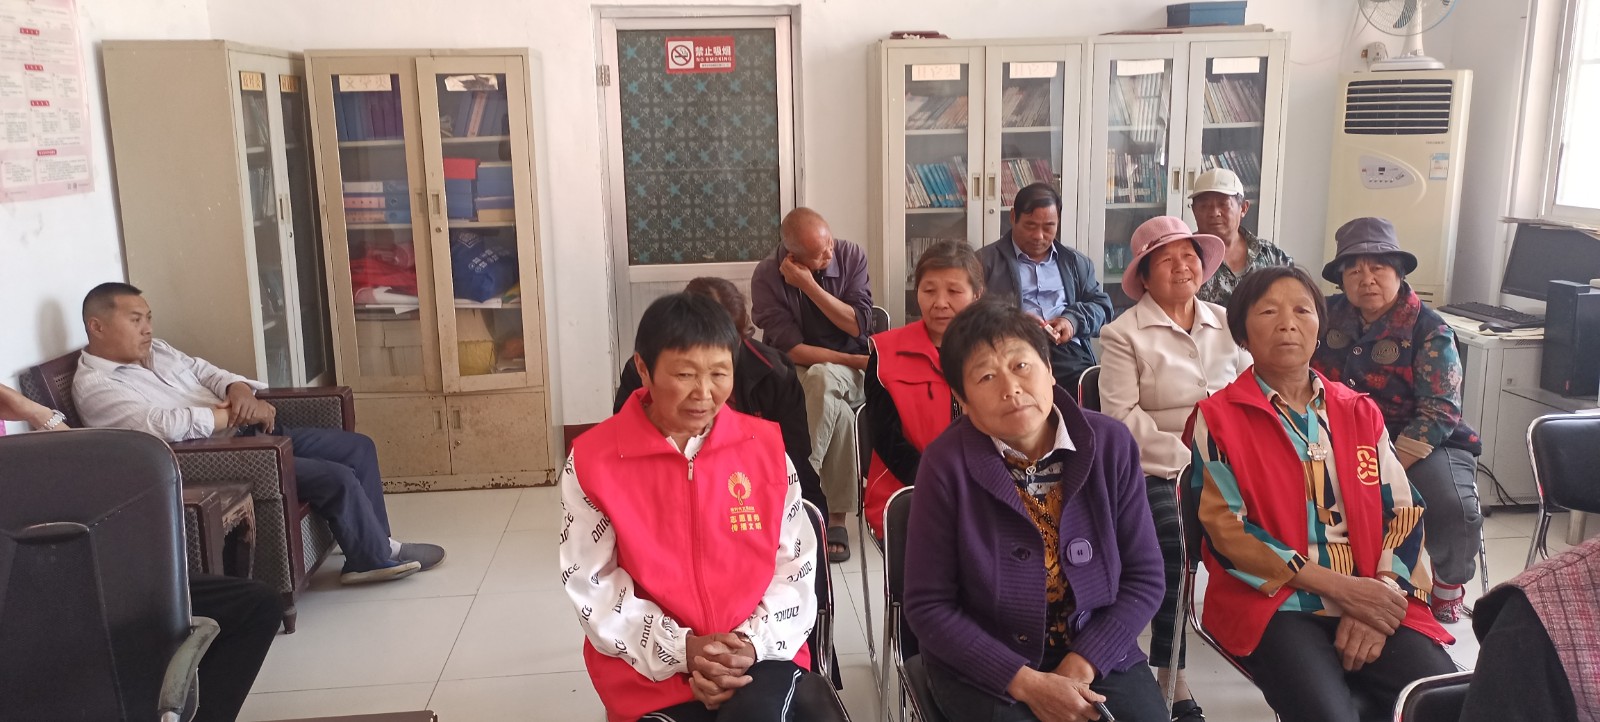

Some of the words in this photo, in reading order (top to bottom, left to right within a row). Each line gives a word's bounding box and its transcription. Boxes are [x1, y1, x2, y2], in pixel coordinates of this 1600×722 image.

[695, 45, 731, 57] 禁止吸烟
[731, 521, 762, 533] 传播文明
